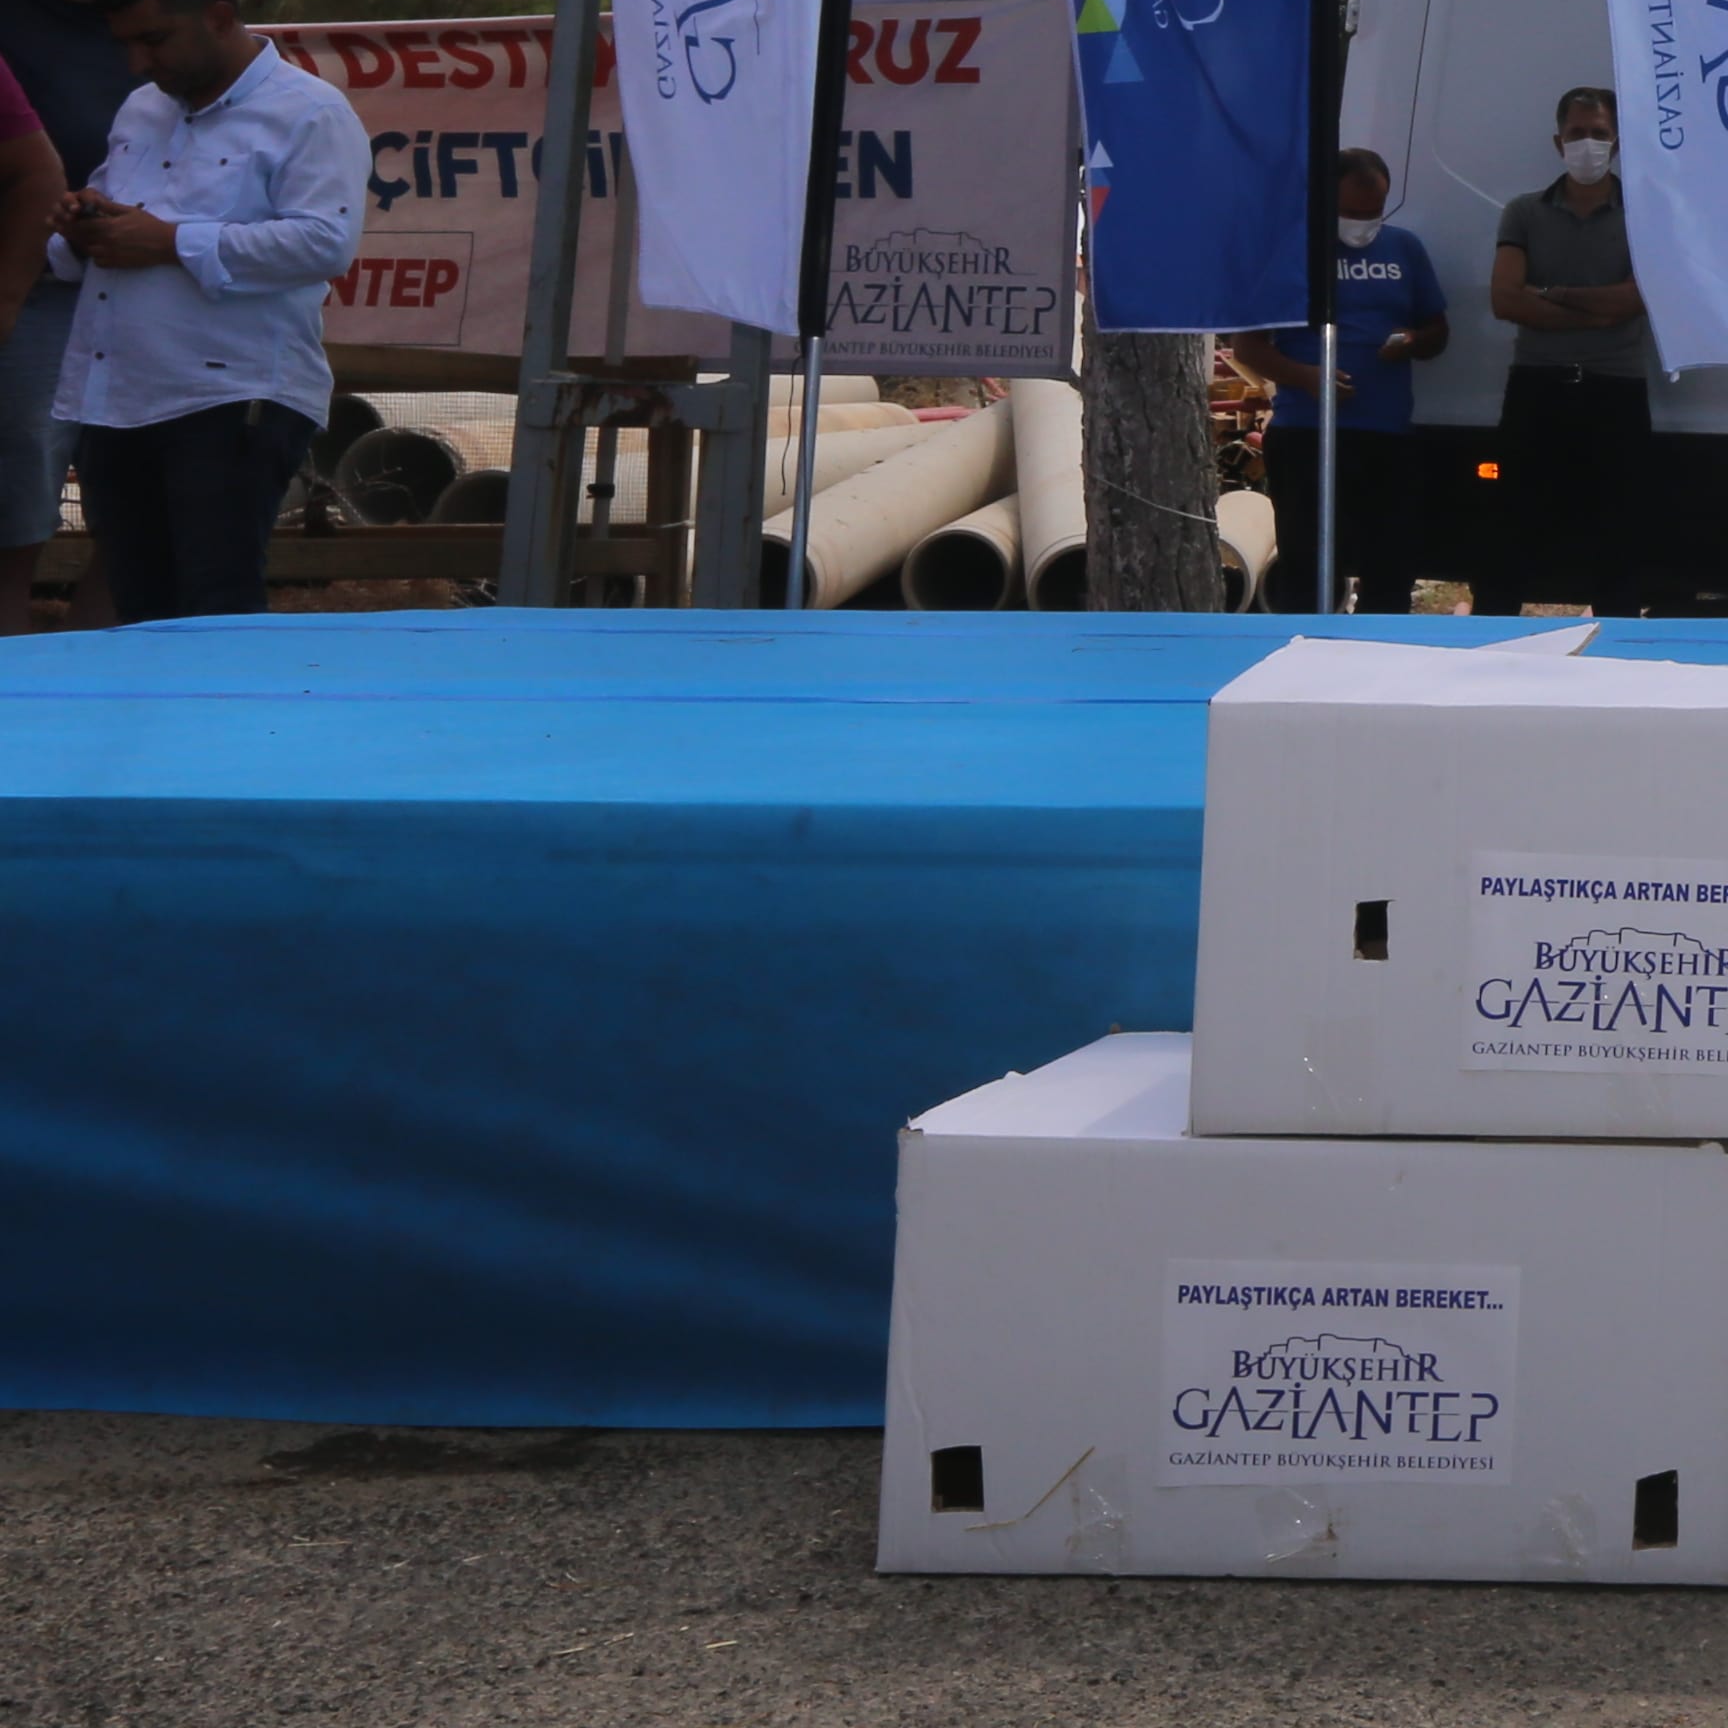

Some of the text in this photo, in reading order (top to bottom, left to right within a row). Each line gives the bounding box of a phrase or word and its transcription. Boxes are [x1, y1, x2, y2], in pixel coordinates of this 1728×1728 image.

[845, 243, 1015, 280] BÜYÜKŞEHİR
[1337, 258, 1402, 280] idas
[824, 276, 1056, 335] AZİANTEP
[879, 341, 973, 359] BÜYÜKŞEHİR
[975, 344, 1054, 360] BELEDİYESİ
[1481, 877, 1617, 904] PAYLAŞTIKÇA
[1623, 881, 1690, 902] ARTAN
[1472, 1041, 1573, 1058] GAZİANTEP
[1578, 1043, 1691, 1062] BÜYÜKŞEHİR
[1177, 1284, 1504, 1311] PAYLAŞTIKÇA ARTAN BEREKET...
[1232, 1349, 1444, 1386] BÜYÜKŞEHİR
[1172, 1382, 1499, 1442] GAZİANTEP
[1169, 1450, 1495, 1471] GAZİANTEP BÜYÜKŞEHİR BELEDİYESİ
